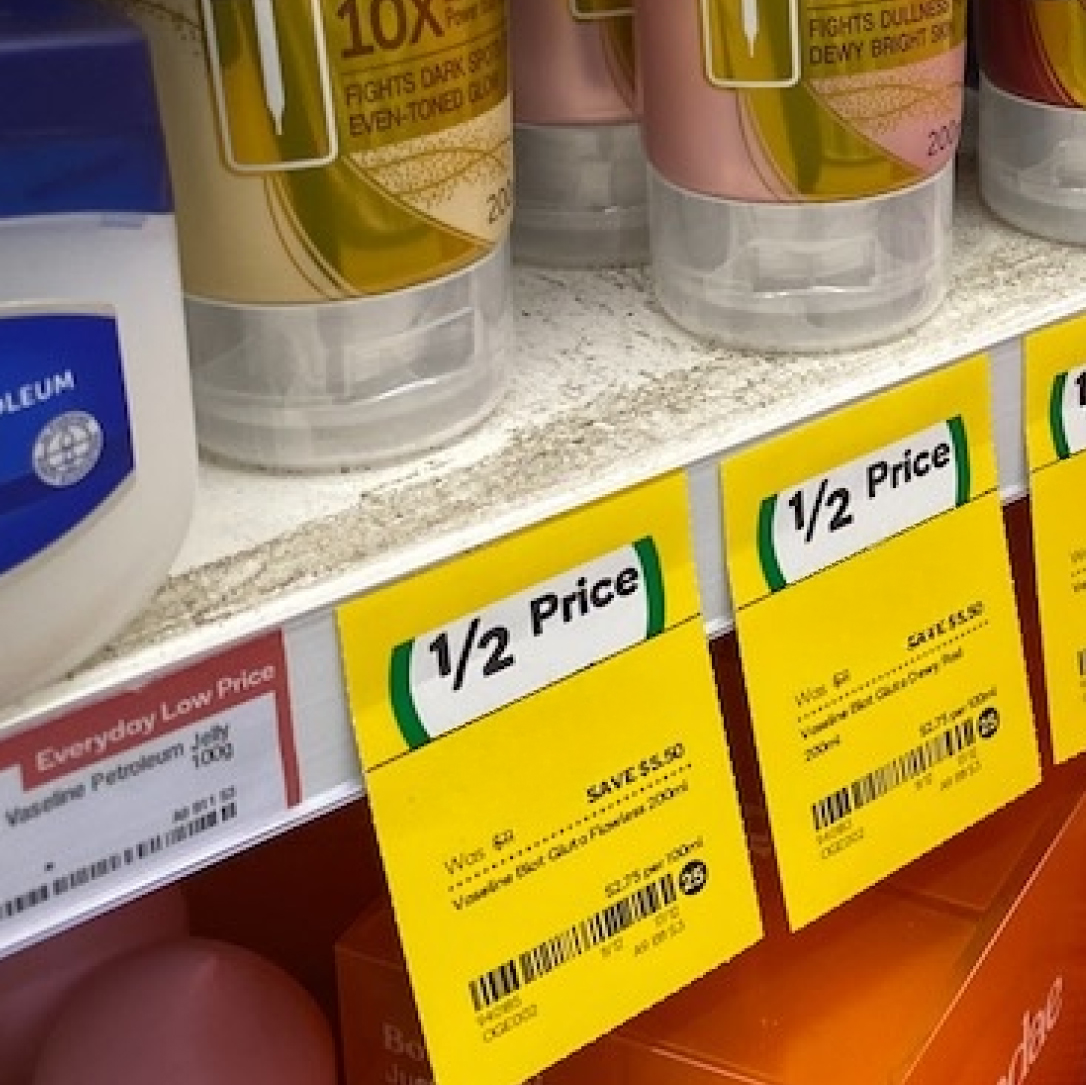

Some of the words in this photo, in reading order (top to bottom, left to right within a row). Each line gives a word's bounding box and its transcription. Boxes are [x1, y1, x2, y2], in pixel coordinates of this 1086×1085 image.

[809, 12, 875, 39] FIGHTS
[809, 41, 864, 65] DEWY
[871, 27, 928, 59] BRIGHT
[345, 71, 416, 106] FIGHTS
[420, 56, 464, 89] DARK
[788, 478, 855, 544] 1/2
[866, 441, 951, 499] Price
[429, 615, 516, 693] 1/2
[529, 566, 640, 637] Price
[35, 711, 156, 771] Everyday
[160, 688, 214, 721] Low
[216, 664, 276, 699] Price
[91, 740, 186, 793] Petroleum
[190, 721, 230, 753] Jelly
[191, 741, 235, 769] 100g
[444, 846, 487, 876] Was
[586, 766, 637, 804] SAVE
[637, 741, 686, 777] $5.50
[451, 872, 514, 911] Vaseline
[548, 833, 589, 862] Gluta
[589, 803, 647, 840] Flawless
[648, 779, 690, 813] 200ml
[680, 862, 707, 891] 25
